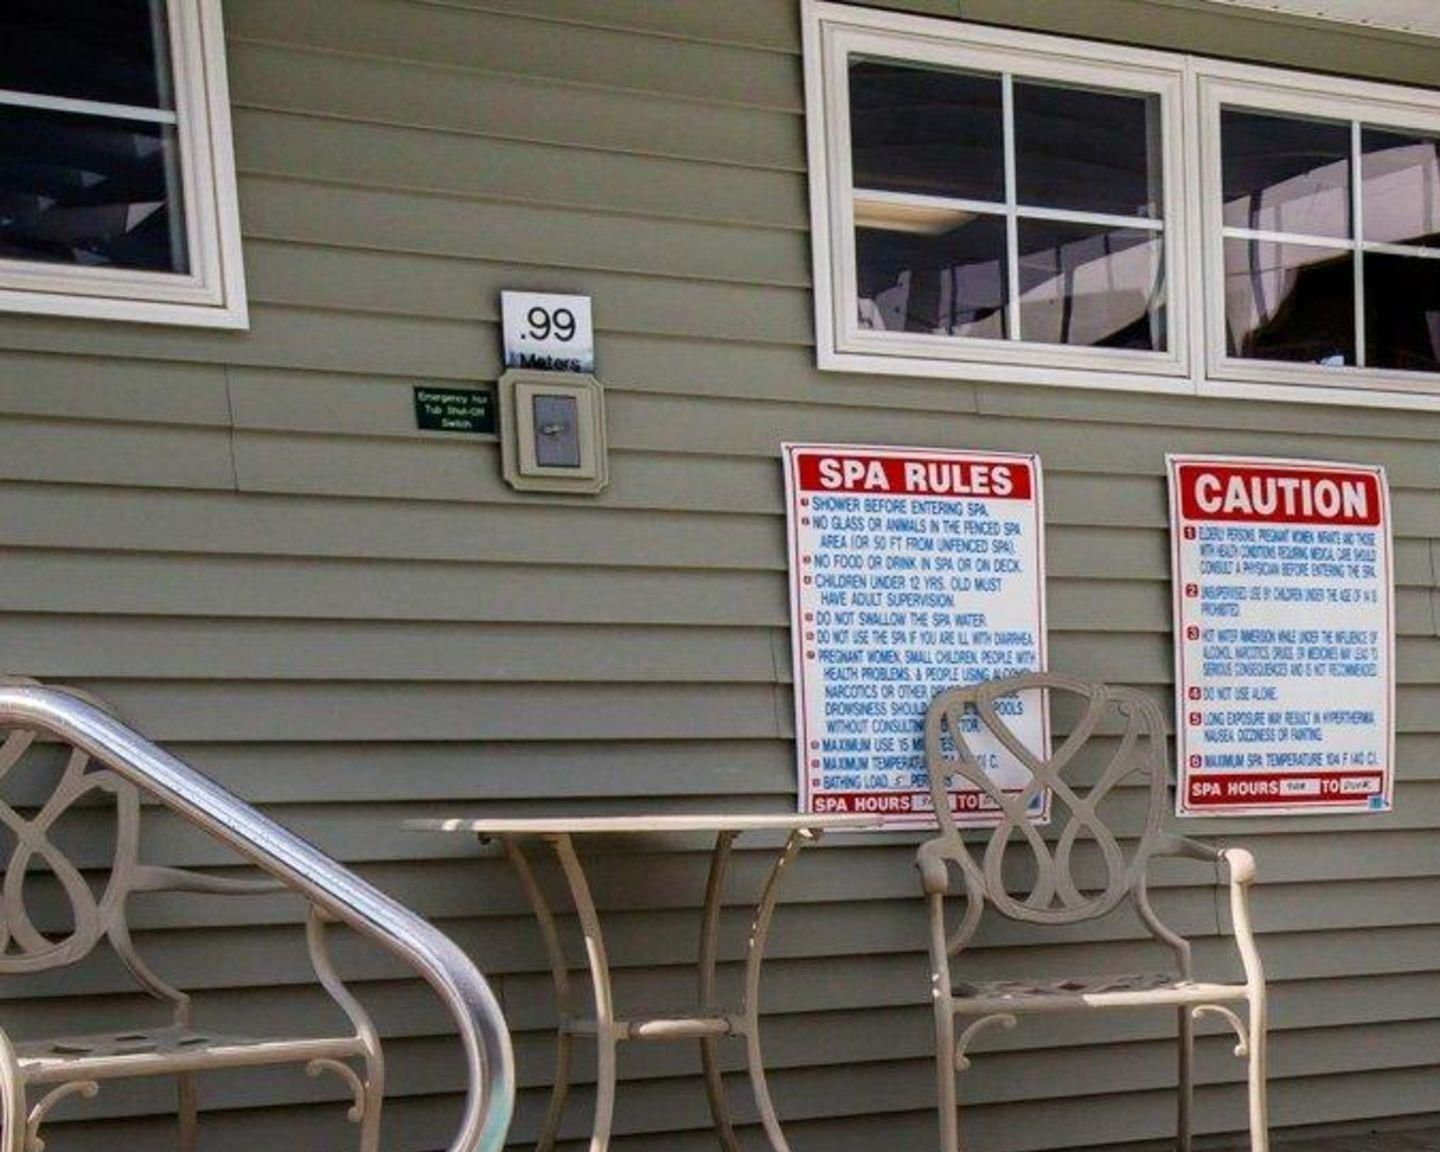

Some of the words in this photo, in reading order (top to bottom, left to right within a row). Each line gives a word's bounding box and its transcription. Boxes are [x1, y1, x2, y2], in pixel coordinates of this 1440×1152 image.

[520, 306, 577, 342] .99
[519, 352, 582, 372] Meters
[418, 391, 467, 405] Emergency
[425, 401, 442, 415] Tub
[441, 414, 473, 428] Switch
[819, 458, 890, 490] SPA
[904, 463, 1013, 496] RULES
[1194, 473, 1368, 518] CAUTION
[812, 497, 859, 511] SHOWER
[864, 498, 906, 513] BEFORE
[911, 500, 962, 514] ENTERING
[813, 515, 827, 530] NO
[831, 515, 864, 531] GLASS
[868, 516, 881, 531] OR
[886, 517, 925, 532] ANIMALS
[930, 518, 939, 533] IN
[942, 518, 960, 533] THE
[964, 519, 1000, 534] FENCED
[821, 534, 846, 549] AREA
[906, 536, 932, 551] FROM
[937, 537, 987, 552] UNFENCED
[814, 553, 829, 567] NO
[834, 554, 863, 568] FOOD
[868, 554, 881, 568] OR
[885, 555, 916, 569] DRINK
[921, 556, 930, 569] IN
[935, 556, 953, 570] SPA
[957, 557, 971, 570] OR
[975, 557, 989, 571] ON
[815, 573, 866, 588] CHILDREN
[870, 575, 905, 589] UNDER
[910, 576, 920, 589] 12
[951, 577, 970, 590] OLD
[974, 577, 1001, 591] MUST
[820, 591, 846, 606] HAVE
[851, 592, 881, 606] ADULT
[817, 611, 830, 624] DO
[834, 611, 853, 625] NOT
[859, 612, 904, 626] SWALLOW
[910, 613, 928, 626] THE
[932, 613, 950, 627] SPA
[817, 629, 829, 643] DO
[832, 629, 848, 643] NOT
[853, 629, 868, 643] USE
[872, 630, 888, 644] THE
[891, 630, 906, 644] SPA
[909, 631, 916, 644] IF
[920, 631, 935, 645] YOU
[938, 631, 954, 645] ARE
[958, 632, 968, 645] ILL
[972, 632, 991, 646] WITH
[818, 648, 862, 662] PREGNANT
[905, 650, 932, 664] SMALL
[981, 652, 1012, 665] PEOPLE
[1016, 652, 1035, 666] WITH
[823, 666, 857, 680] HEALTH
[926, 668, 958, 681] PEOPLE
[961, 669, 990, 682] USING
[825, 684, 877, 698] NARCOTICS
[881, 685, 894, 698] OR
[898, 685, 927, 698] OTHER
[825, 701, 886, 715] DROWSINESS
[891, 702, 927, 715] SHOULD
[826, 718, 868, 733] WITHOUT
[872, 719, 924, 733] CONSULTIN
[822, 736, 871, 751] MAXIMUM
[874, 737, 894, 751] USE
[822, 757, 869, 770] MAXIMUM
[1204, 753, 1244, 767] MAXIMUM
[1247, 753, 1262, 767] SPA
[1267, 752, 1322, 766] TEMPERATURE
[823, 775, 861, 789] BATHING
[864, 775, 888, 789] LOAD
[1192, 784, 1222, 797] SPA
[1227, 780, 1279, 796] HOURS
[1322, 779, 1339, 793] TO
[815, 796, 848, 812] SPA
[854, 795, 910, 811] HOURS
[957, 794, 978, 810] TO
